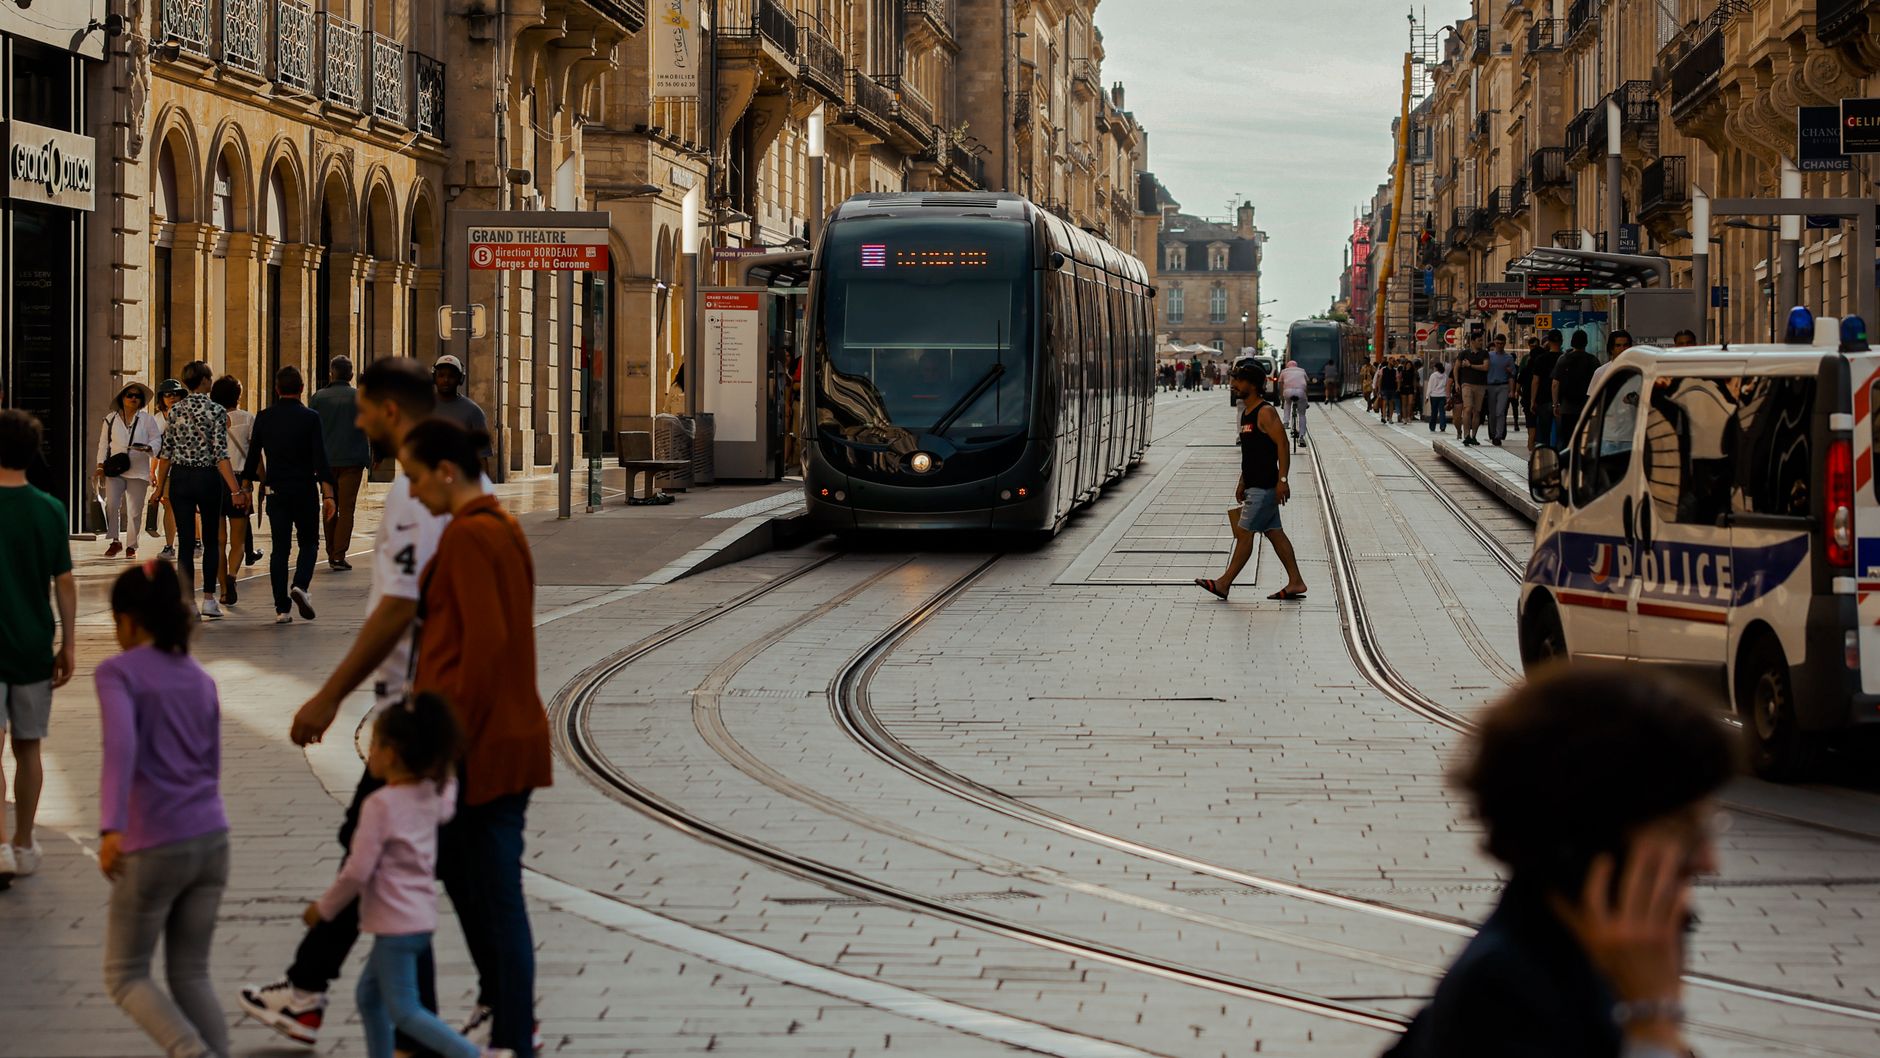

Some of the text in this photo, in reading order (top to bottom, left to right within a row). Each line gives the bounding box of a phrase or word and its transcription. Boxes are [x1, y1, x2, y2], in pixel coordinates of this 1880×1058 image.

[1803, 160, 1849, 169] CHANGE
[472, 230, 566, 243] GRAND THEATRE
[495, 246, 531, 257] direction
[534, 247, 578, 258] BORDEAUX
[495, 258, 590, 270] Berges de la Garonne
[1538, 317, 1549, 327] 25
[394, 543, 415, 575] 4
[1617, 544, 1732, 599] POLICE
